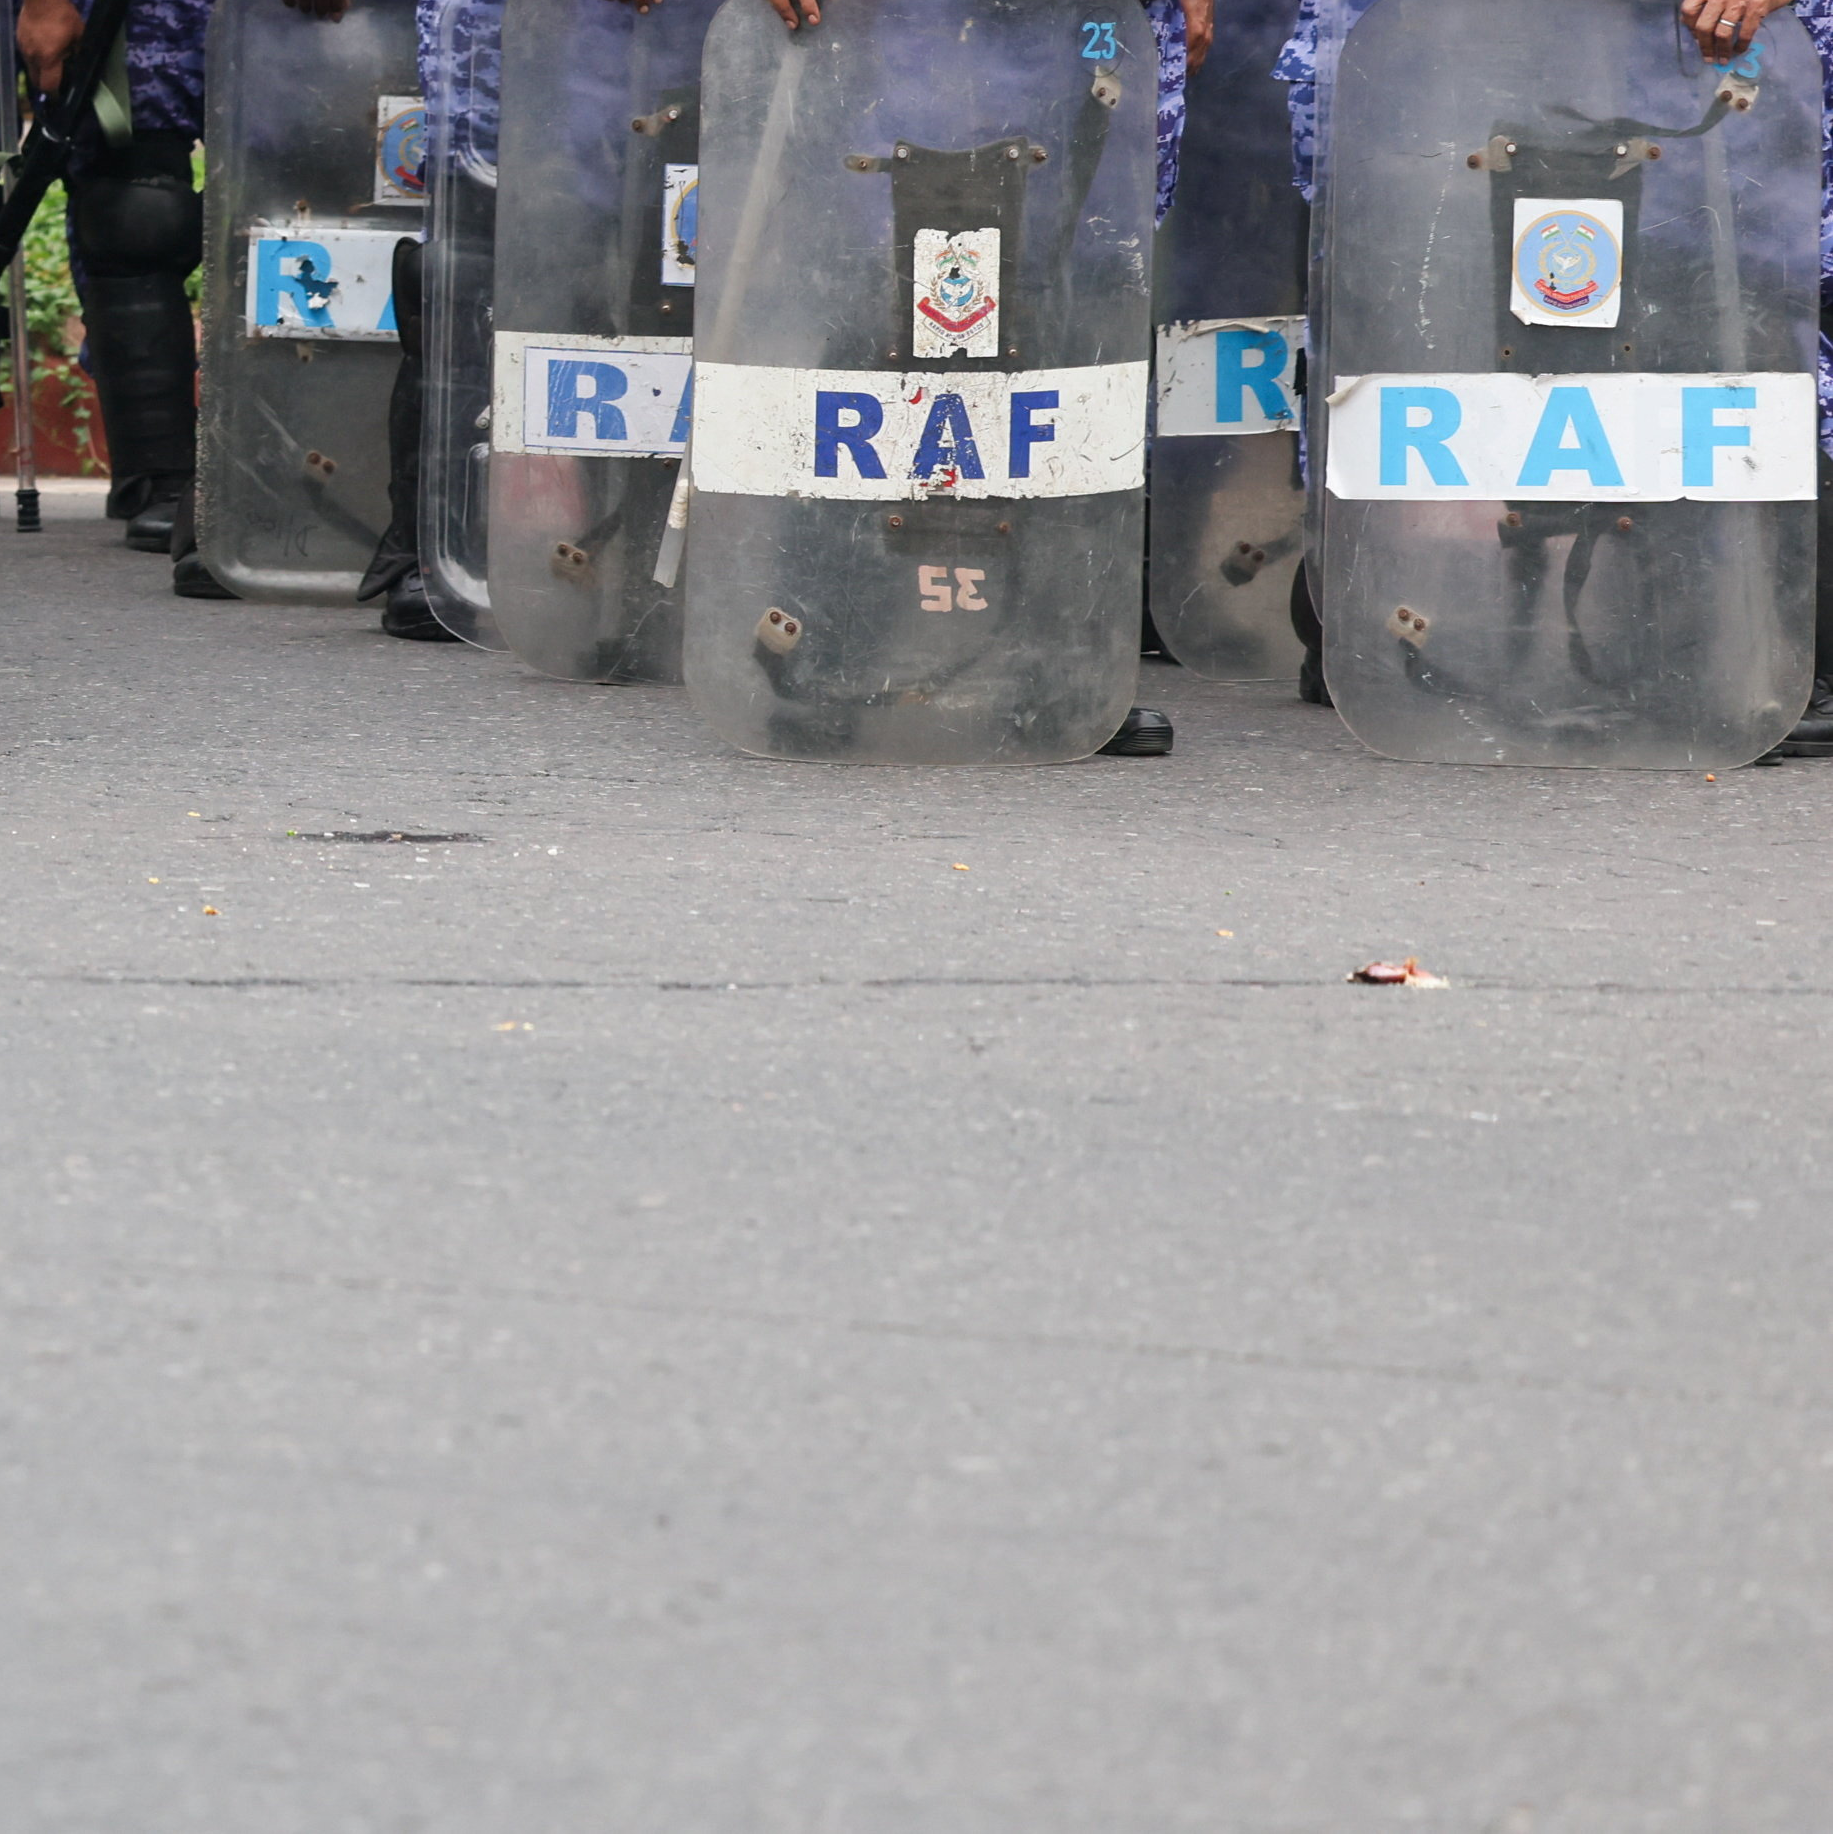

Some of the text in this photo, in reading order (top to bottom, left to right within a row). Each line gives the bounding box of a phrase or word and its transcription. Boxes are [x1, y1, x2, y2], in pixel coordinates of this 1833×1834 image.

[1080, 22, 1117, 60] 23
[256, 239, 396, 330] R
[548, 360, 692, 443] R
[815, 391, 1059, 479] RAF
[1379, 387, 1757, 487] RAF
